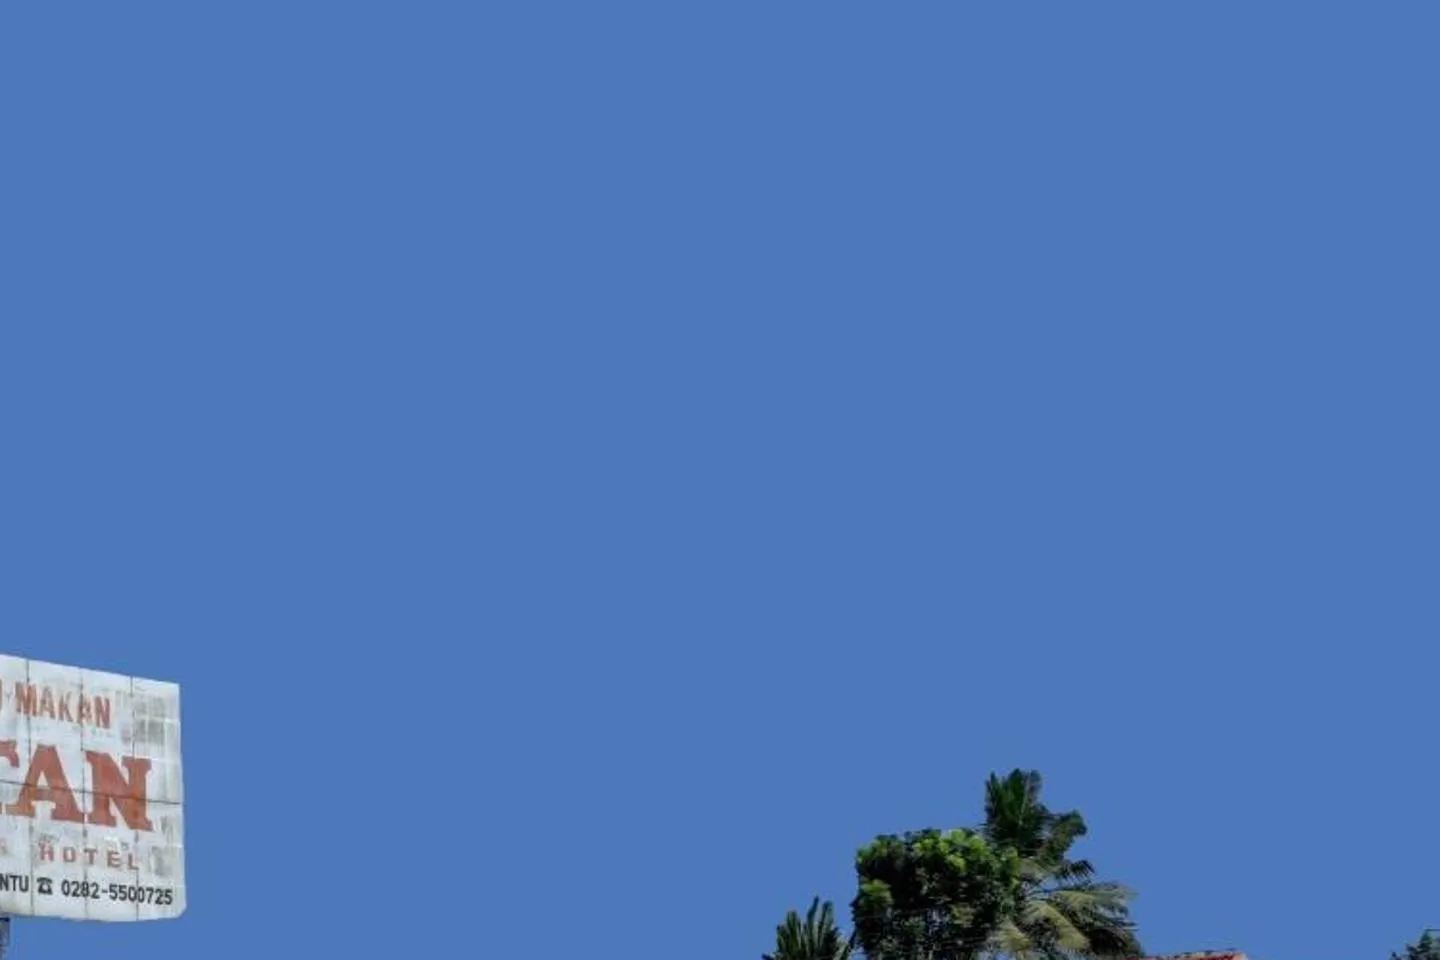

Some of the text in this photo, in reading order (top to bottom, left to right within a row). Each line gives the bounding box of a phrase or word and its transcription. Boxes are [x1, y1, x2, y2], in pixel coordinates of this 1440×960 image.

[14, 681, 111, 729] MAKAN
[38, 841, 140, 871] HOTEL
[60, 879, 173, 905] 0282-5500725
